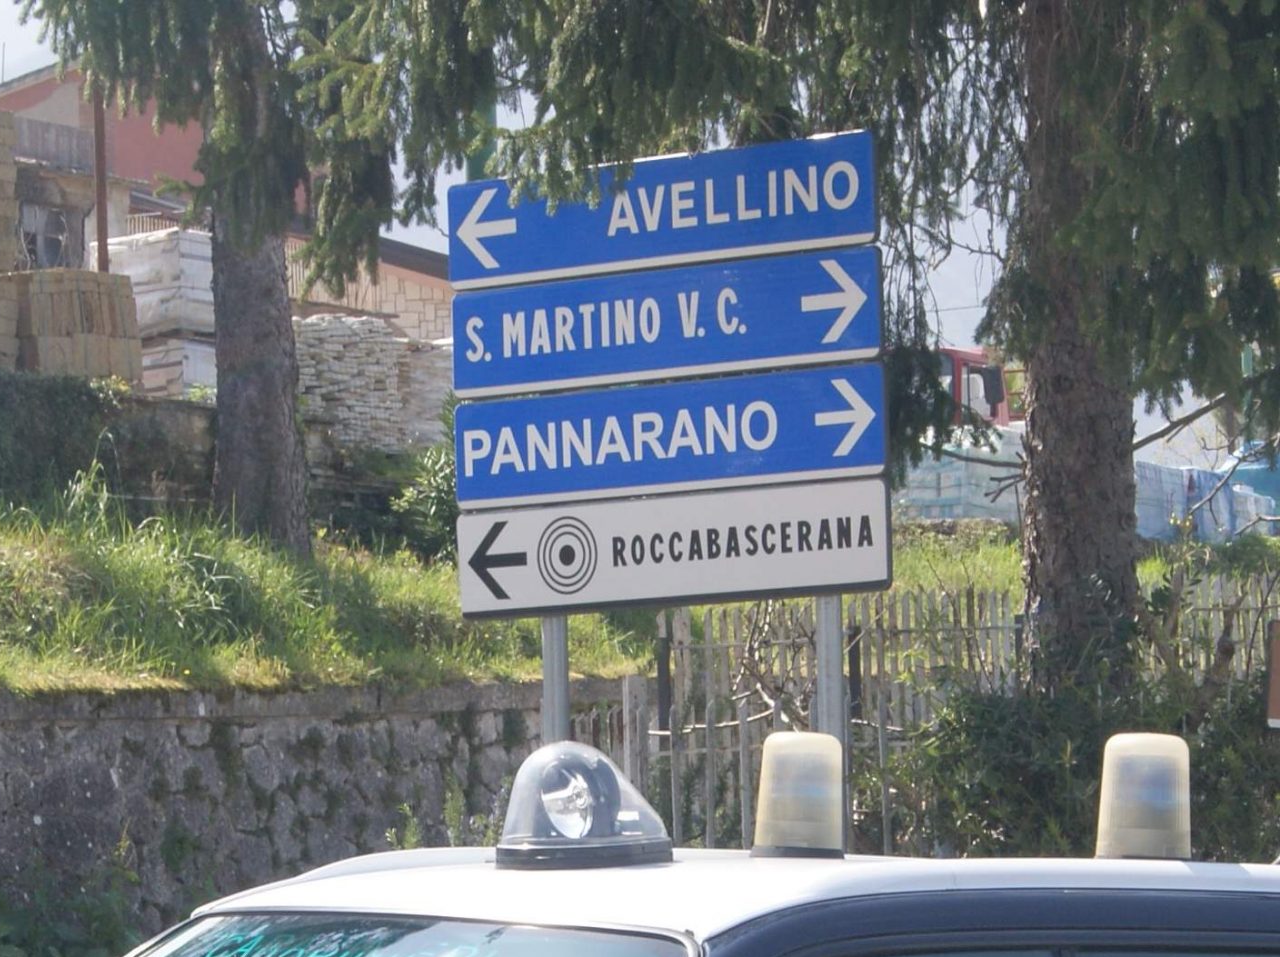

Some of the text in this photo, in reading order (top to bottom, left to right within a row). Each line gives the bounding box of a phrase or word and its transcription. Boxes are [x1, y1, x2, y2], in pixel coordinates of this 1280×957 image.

[607, 160, 859, 237] AVELLINO
[466, 287, 747, 362] S. MARTINO V. C.
[463, 400, 778, 477] PANNARANO
[612, 514, 873, 567] ROCCABASCERANA
